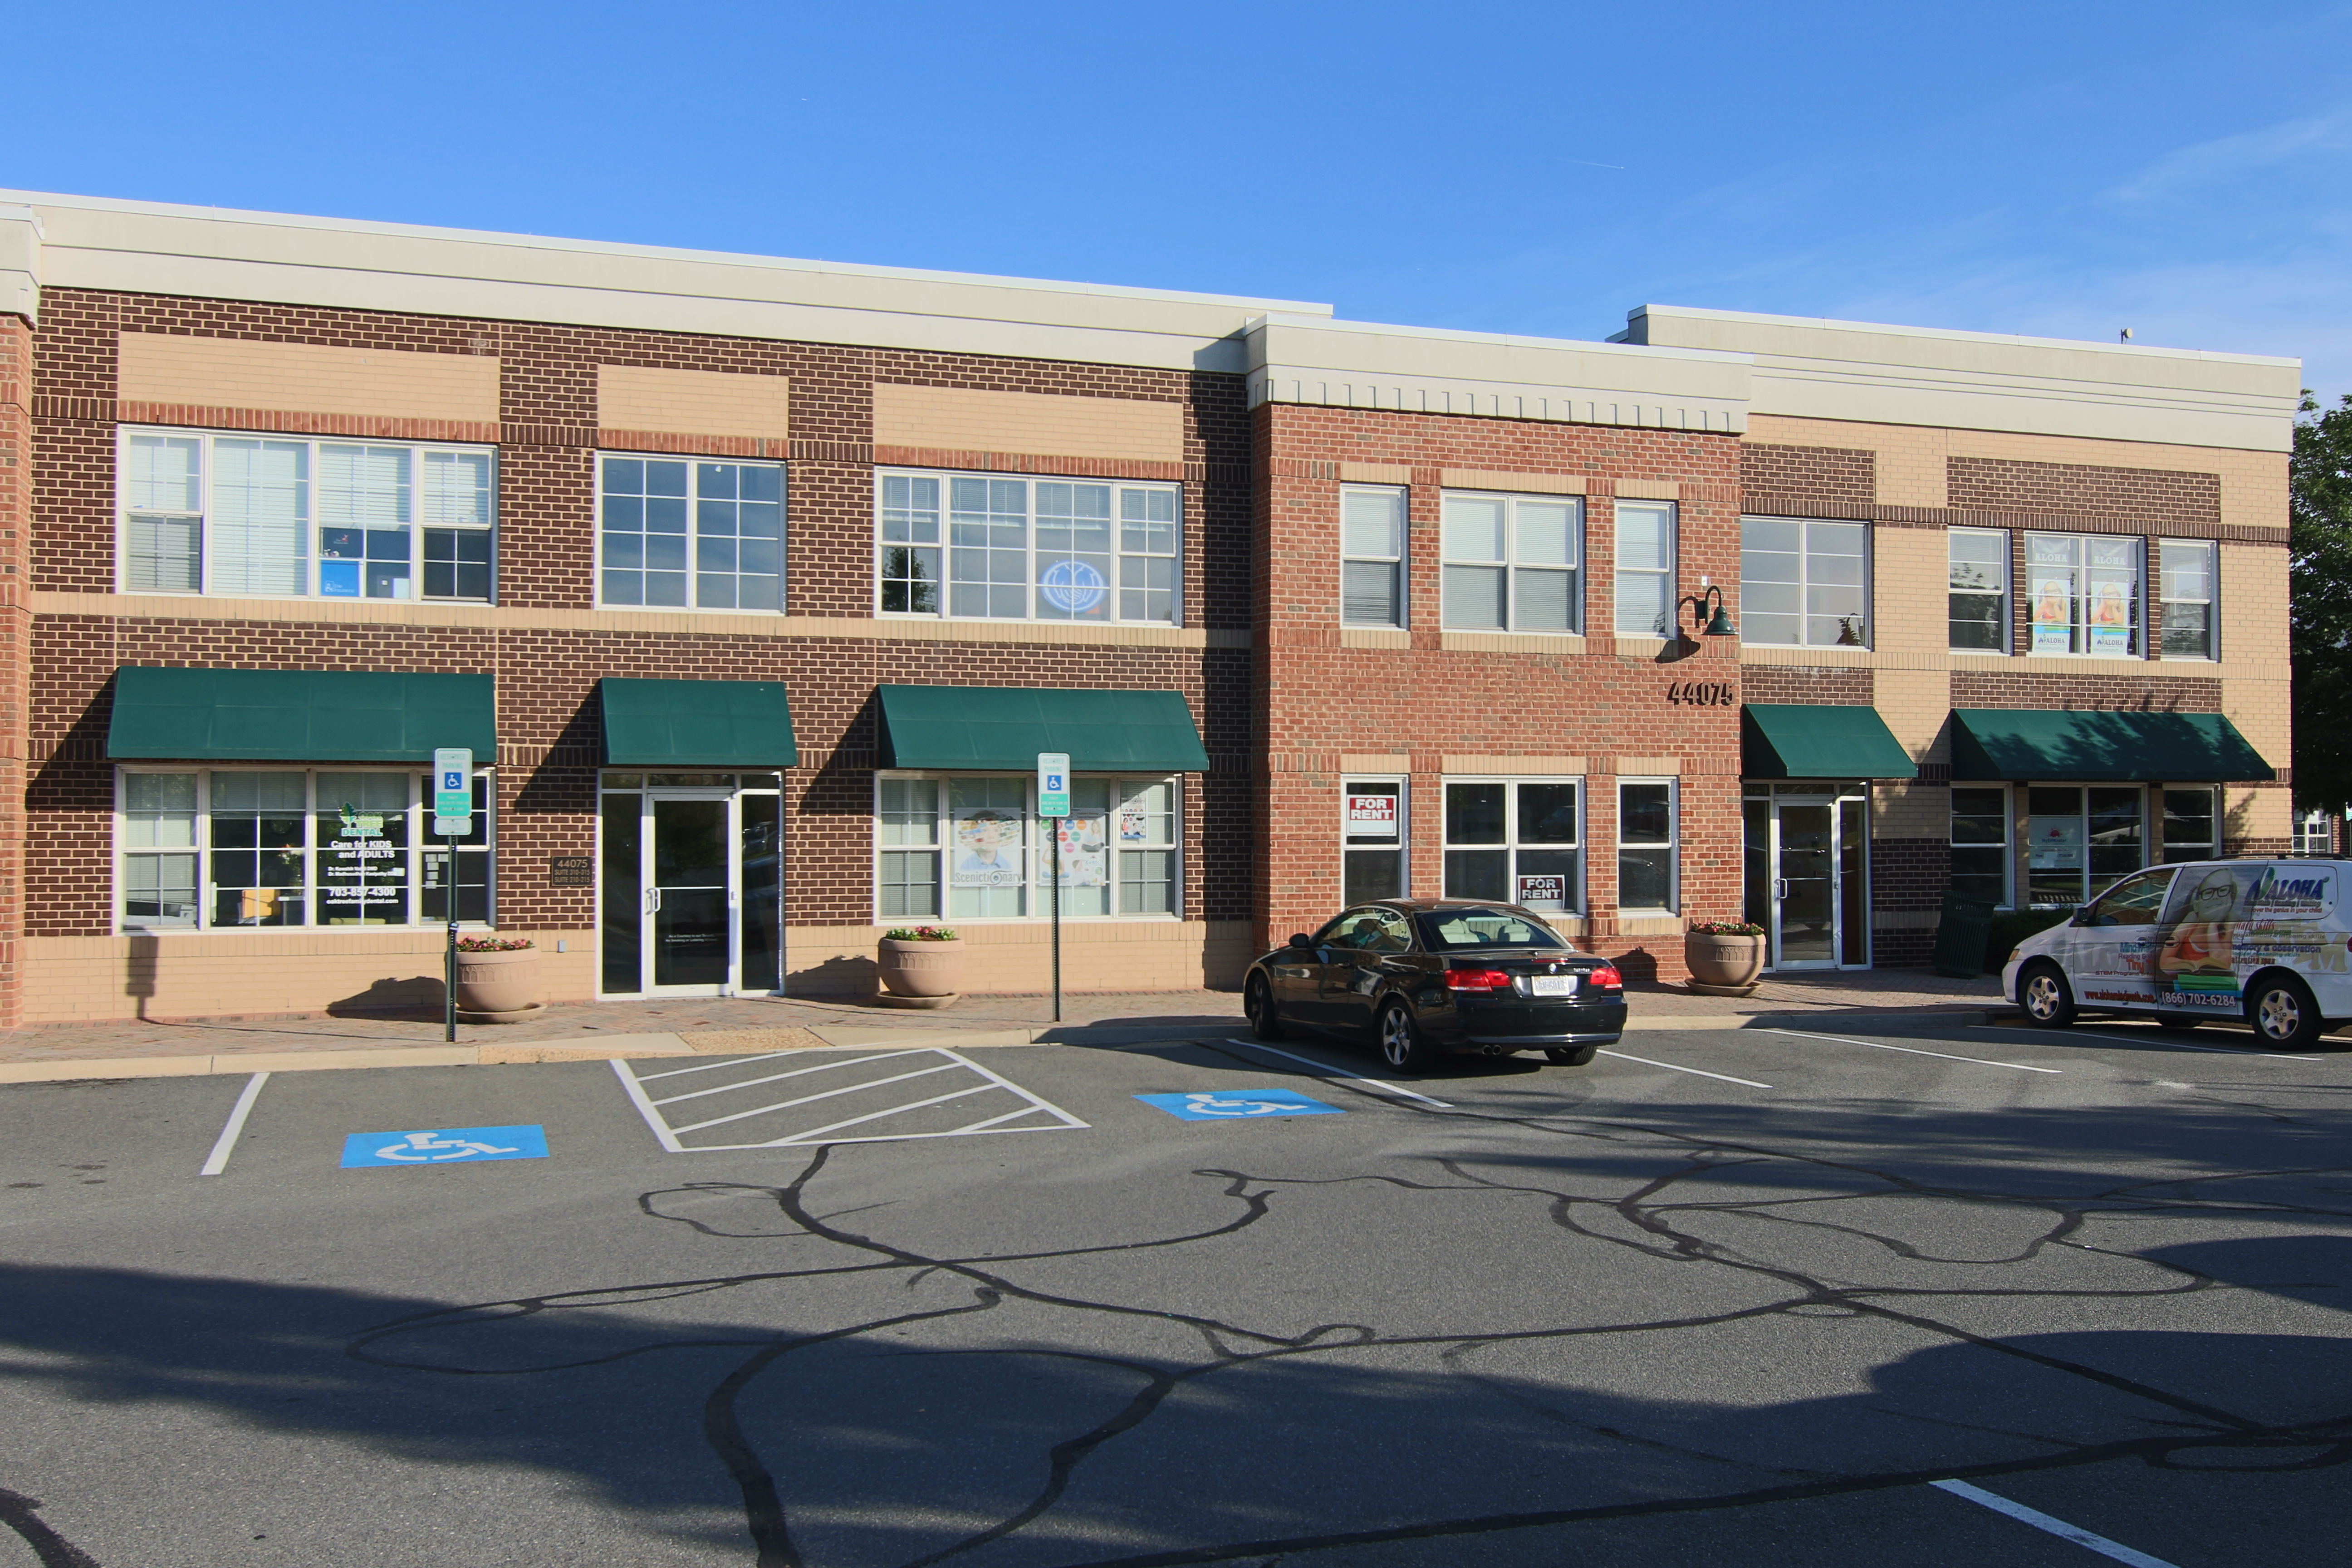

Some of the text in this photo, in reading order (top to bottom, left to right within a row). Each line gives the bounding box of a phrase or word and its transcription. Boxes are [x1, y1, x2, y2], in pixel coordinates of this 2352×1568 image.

[2034, 554, 2068, 562] ALOHA
[2094, 556, 2126, 565] ALOHA
[1671, 681, 1736, 704] 44075
[1356, 799, 1387, 809] FOR
[1351, 809, 1392, 819] RENT
[354, 819, 383, 828] TREE
[342, 828, 383, 836] DENTAL
[557, 859, 588, 867] 44075
[1527, 879, 1556, 888] FOR
[330, 888, 396, 896] 703-857-4300
[1522, 889, 1561, 899] RENT
[2265, 879, 2323, 900] ALOHA
[2272, 945, 2322, 953] observation
[2126, 959, 2144, 973] Tiny
[2161, 991, 2236, 1007] (866) 702-6284
